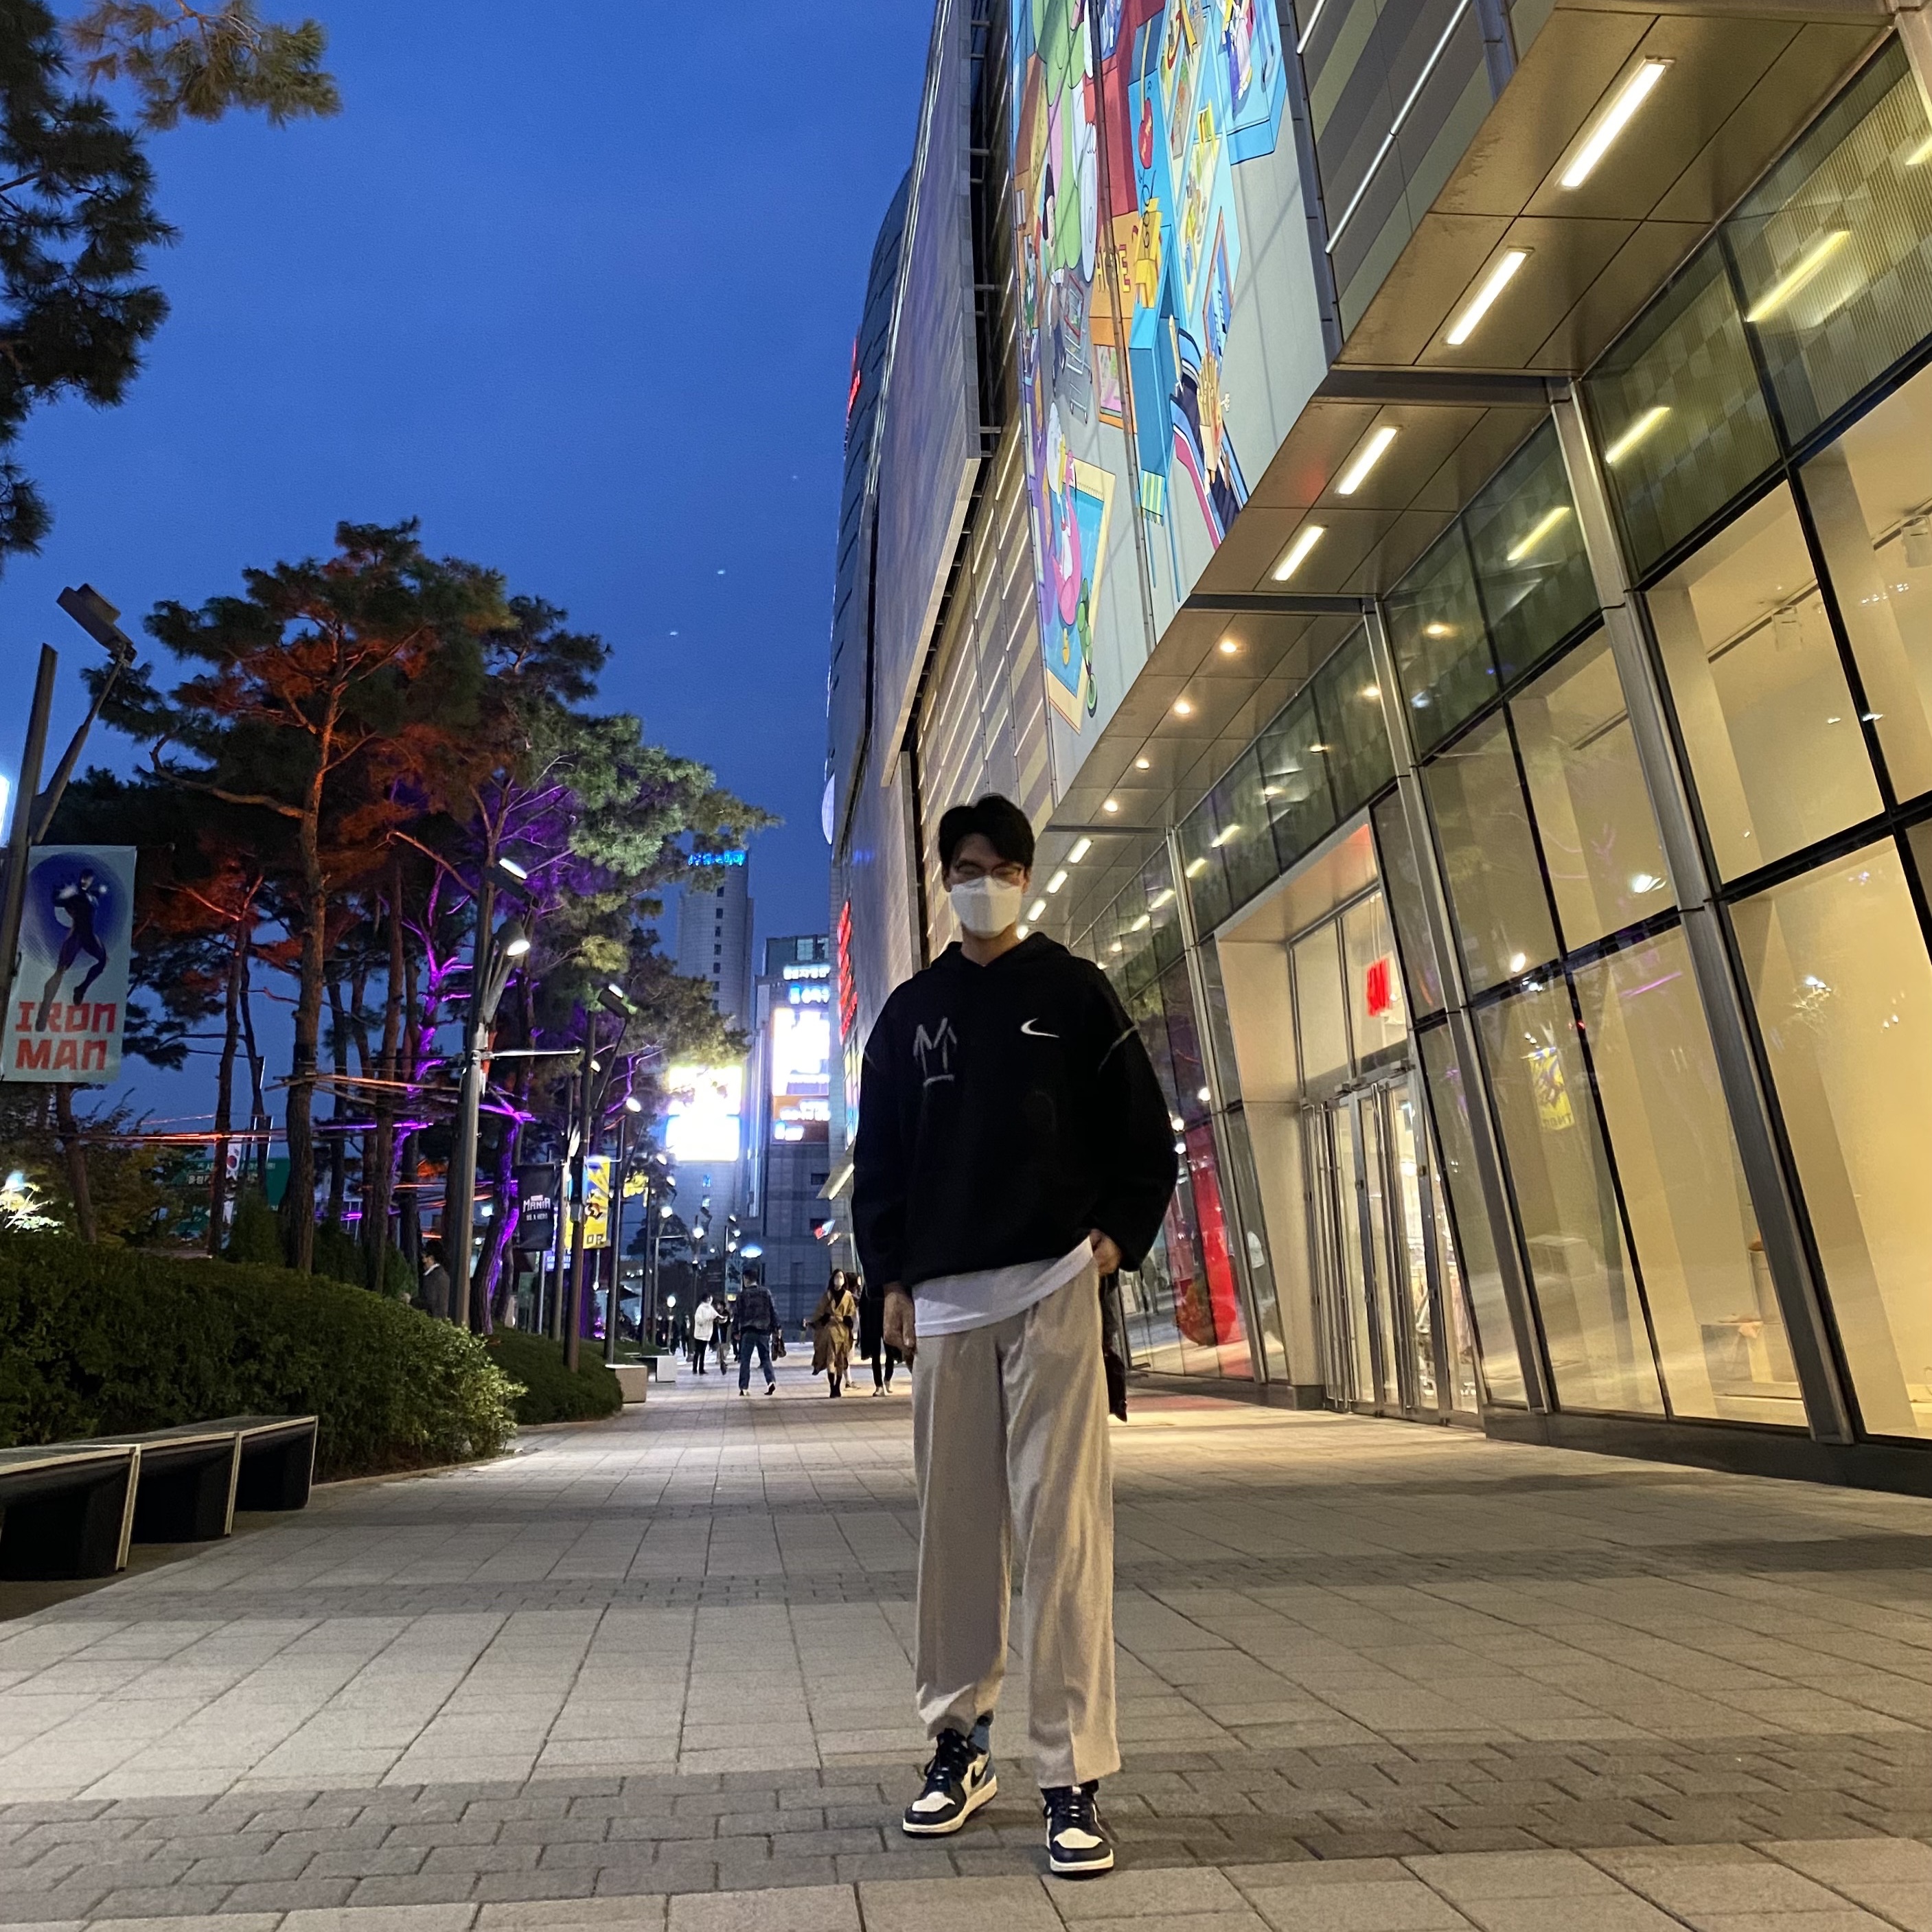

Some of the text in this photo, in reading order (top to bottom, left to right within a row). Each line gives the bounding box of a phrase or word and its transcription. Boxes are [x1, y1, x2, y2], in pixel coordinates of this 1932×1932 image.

[15, 1001, 117, 1033] IRON
[14, 1038, 107, 1070] MAN
[522, 1197, 551, 1213] MANIA
